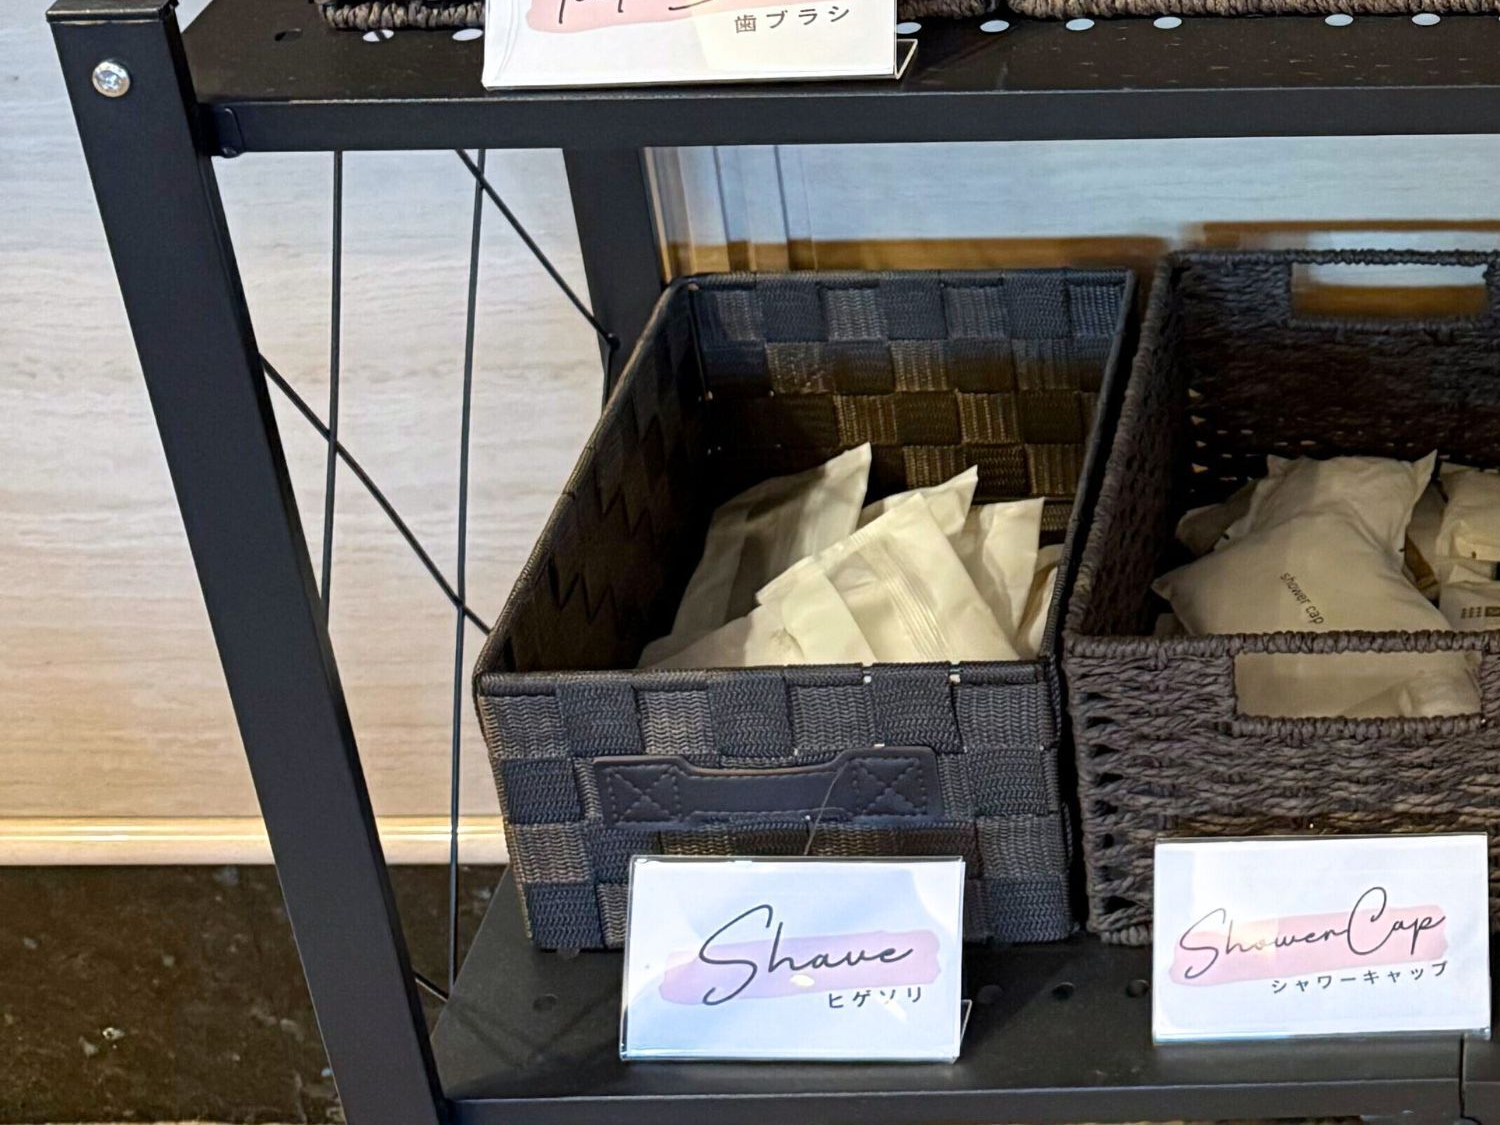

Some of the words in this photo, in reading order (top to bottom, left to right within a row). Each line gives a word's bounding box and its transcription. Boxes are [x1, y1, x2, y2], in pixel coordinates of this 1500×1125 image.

[734, 4, 851, 34] 歯ブラシ
[1280, 572, 1313, 605] shower
[1305, 605, 1325, 625] cap
[698, 903, 914, 1006] Shave
[1271, 960, 1449, 995] シャワーキャップ
[828, 986, 922, 1009] ヒゲソリ
